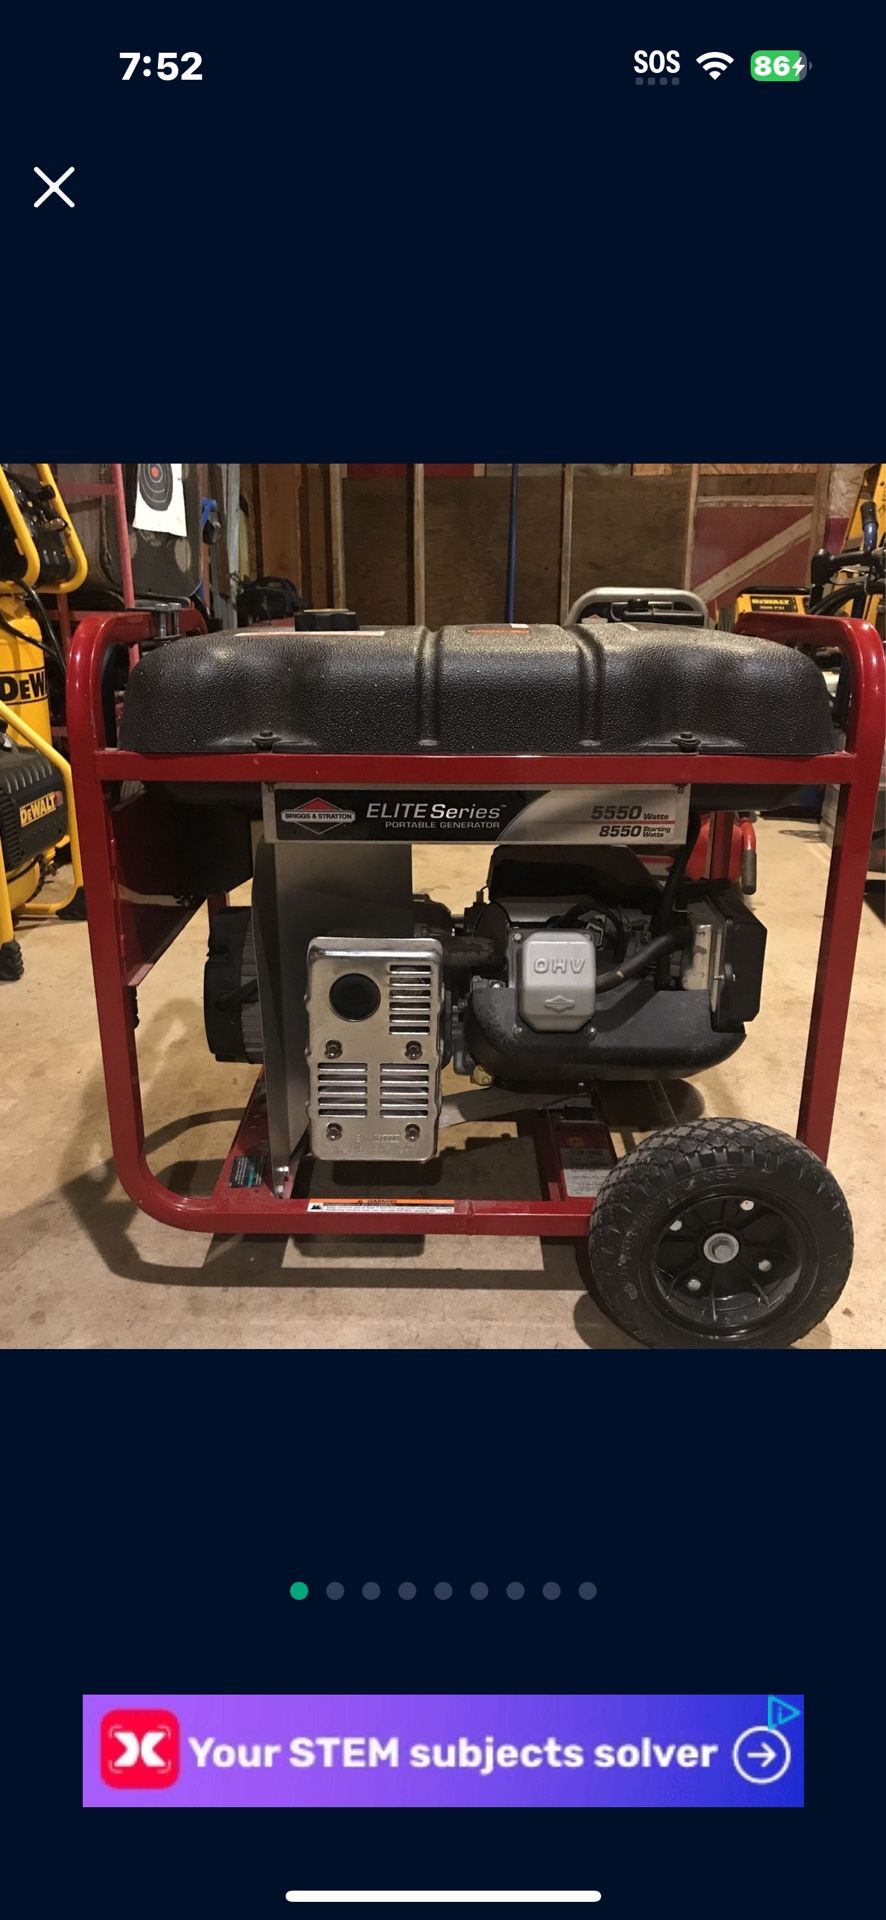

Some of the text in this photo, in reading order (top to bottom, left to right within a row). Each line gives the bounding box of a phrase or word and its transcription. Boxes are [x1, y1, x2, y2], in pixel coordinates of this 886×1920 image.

[366, 803, 428, 818] ELITE
[591, 806, 642, 820] 5550
[599, 825, 641, 838] 8550
[534, 957, 585, 974] OHV
